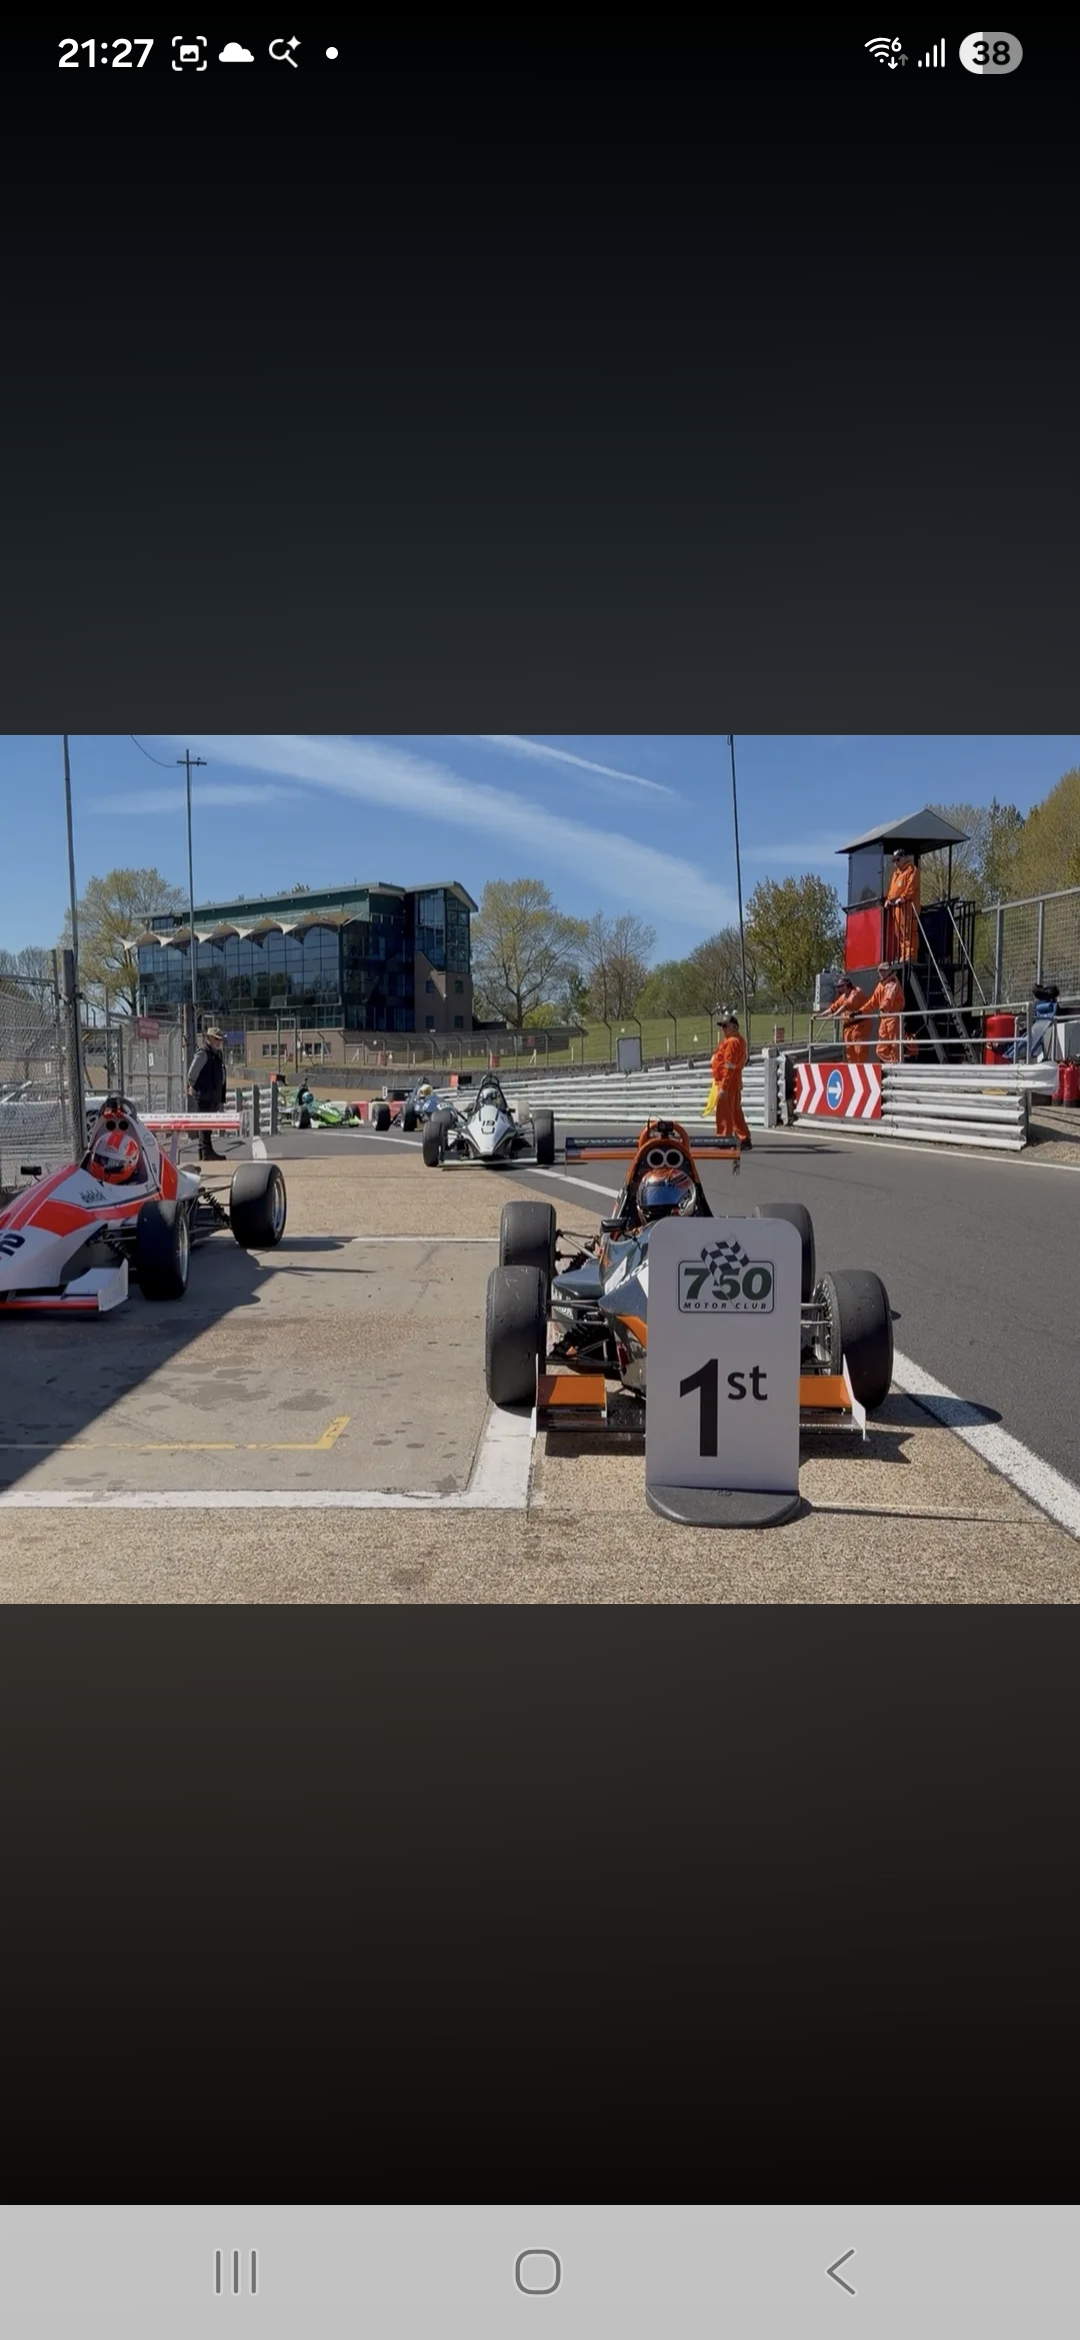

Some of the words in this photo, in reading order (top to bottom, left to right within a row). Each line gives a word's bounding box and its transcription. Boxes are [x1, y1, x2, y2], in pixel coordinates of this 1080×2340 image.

[683, 1266, 774, 1301] 750
[683, 1301, 728, 1310] MOTOR
[734, 1301, 768, 1310] CLUB
[679, 1358, 769, 1458] 1st
